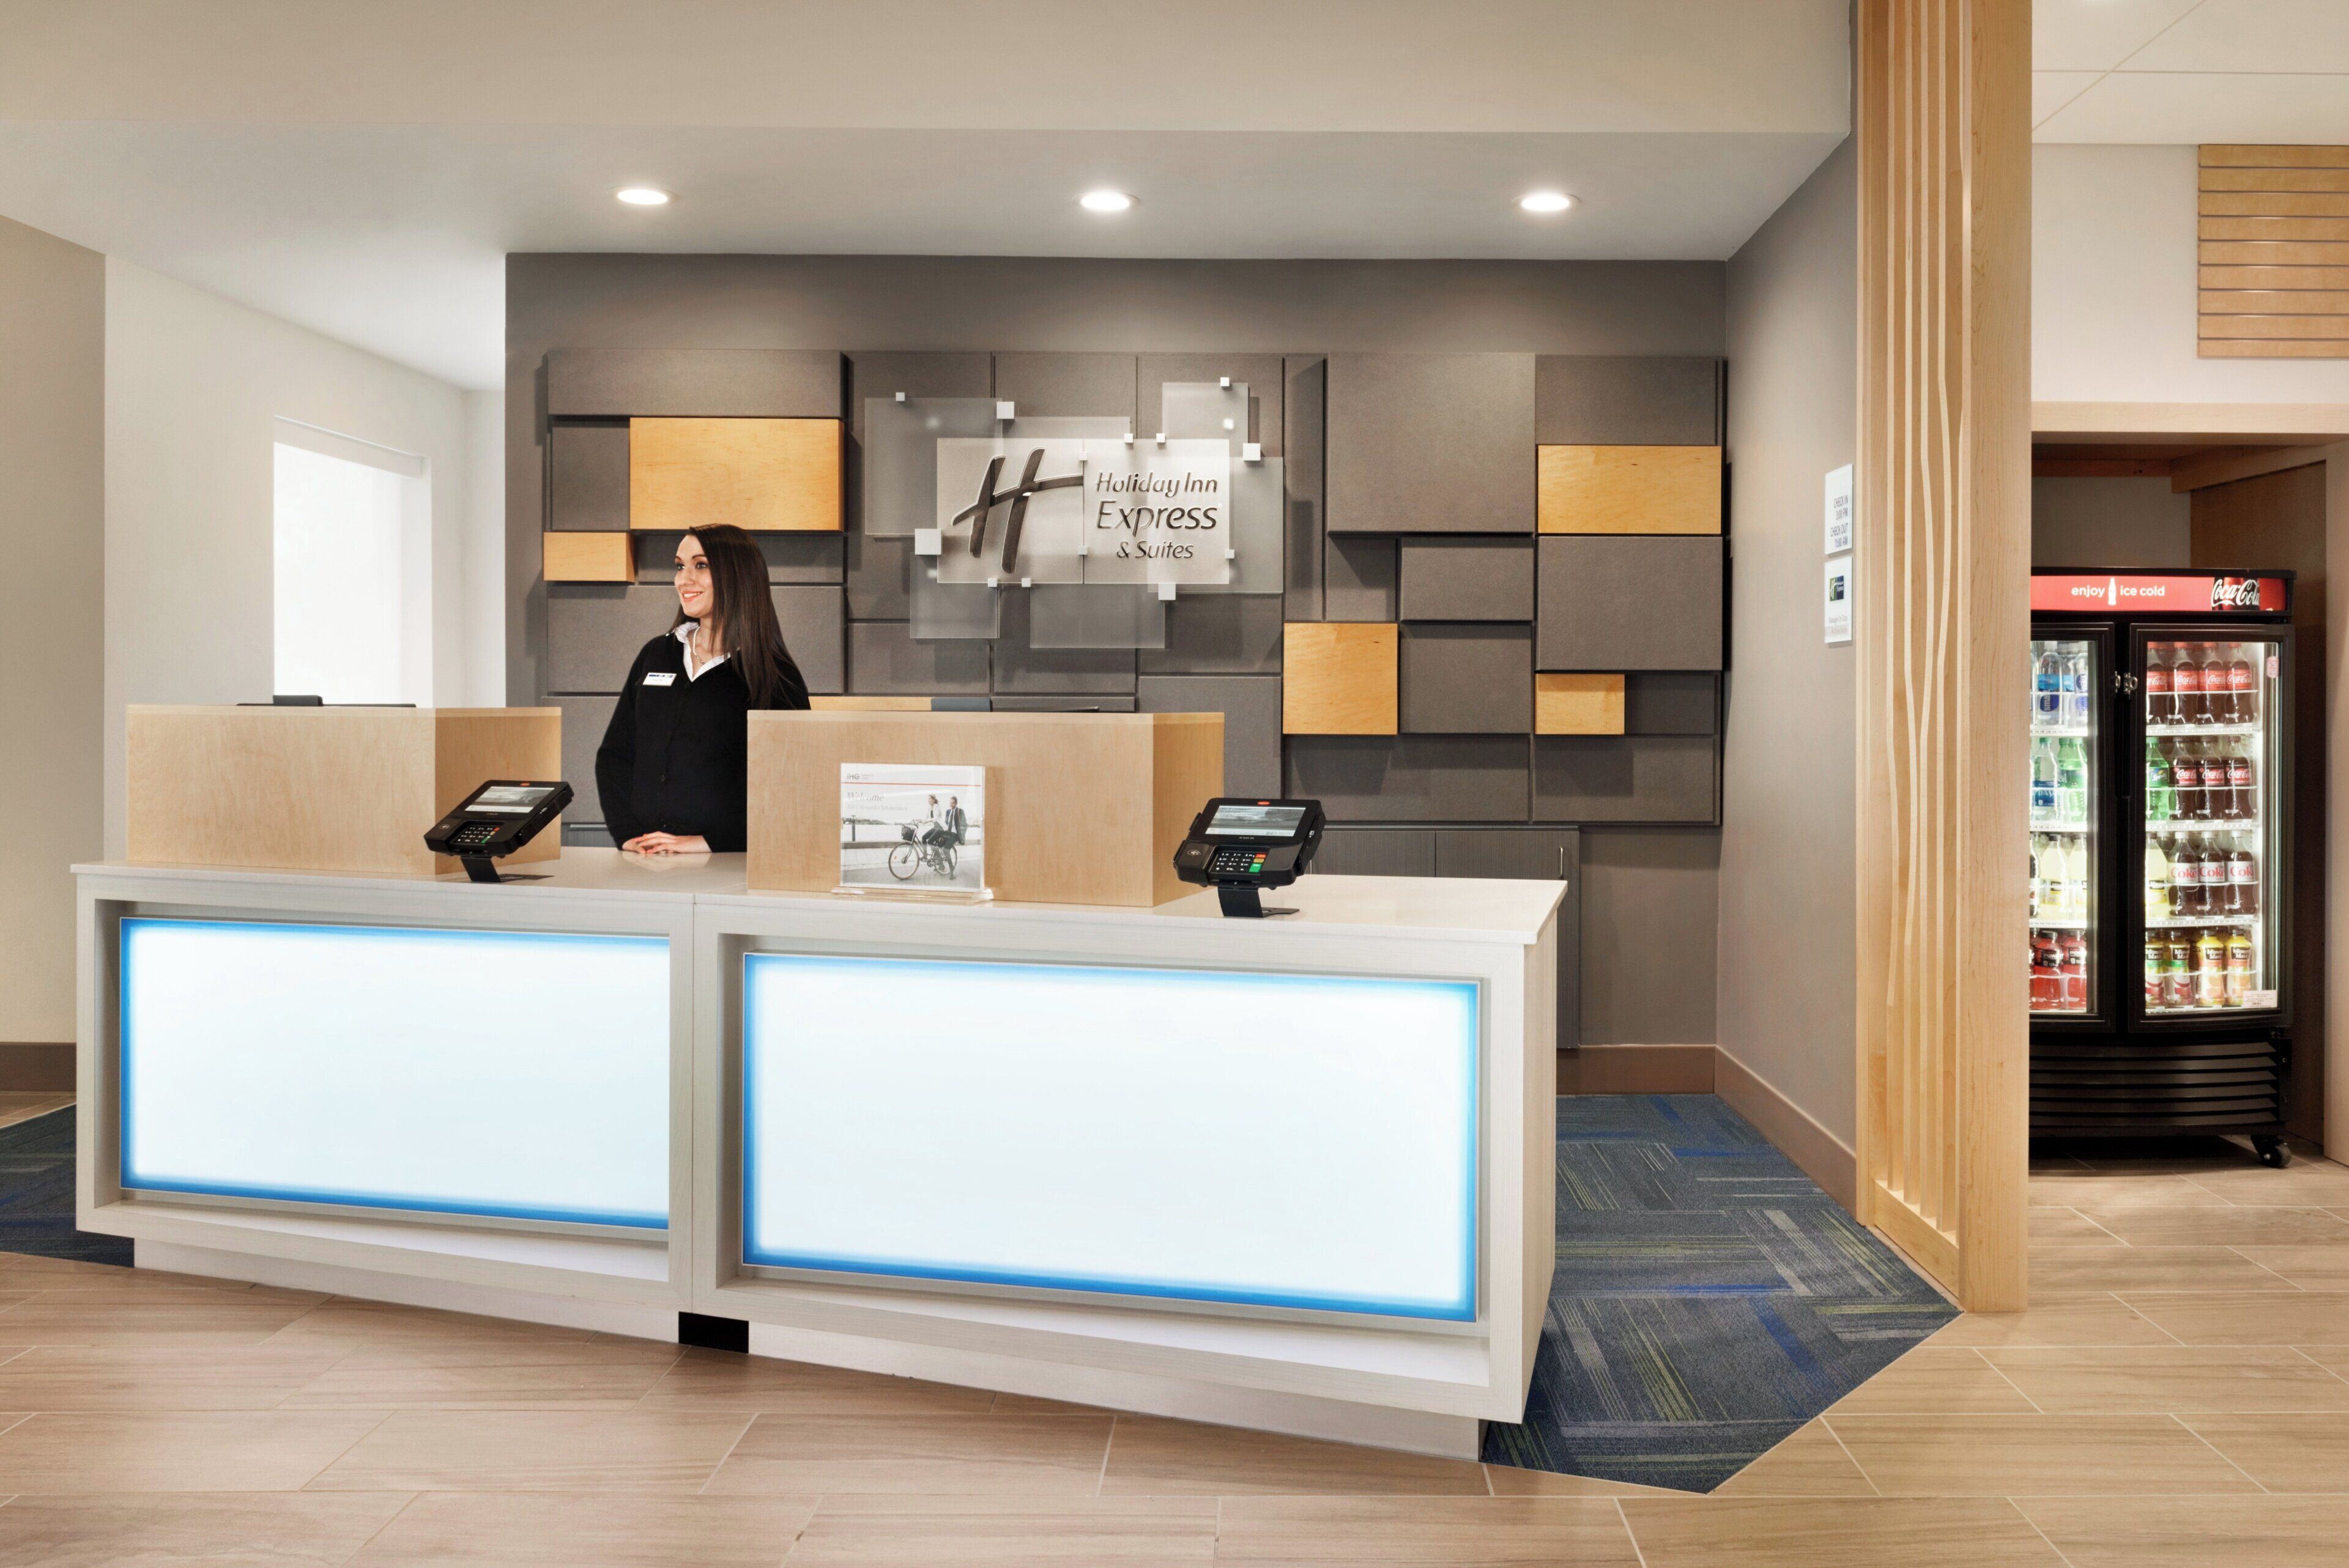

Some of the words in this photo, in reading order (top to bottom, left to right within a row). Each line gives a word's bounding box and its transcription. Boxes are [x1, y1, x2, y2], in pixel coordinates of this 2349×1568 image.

[1096, 470, 1180, 497] Holiday
[1184, 472, 1218, 492] Inn
[1833, 496, 1843, 508] CHECK
[1097, 499, 1218, 537] Express
[1116, 540, 1130, 559] &
[1135, 540, 1194, 559] Suites
[2071, 585, 2105, 598] enjoy
[2120, 585, 2137, 596] ice
[2140, 585, 2165, 596] cold
[2210, 578, 2260, 607] Coca-Cola
[847, 792, 884, 802] Welcome
[2171, 867, 2197, 879] Coke
